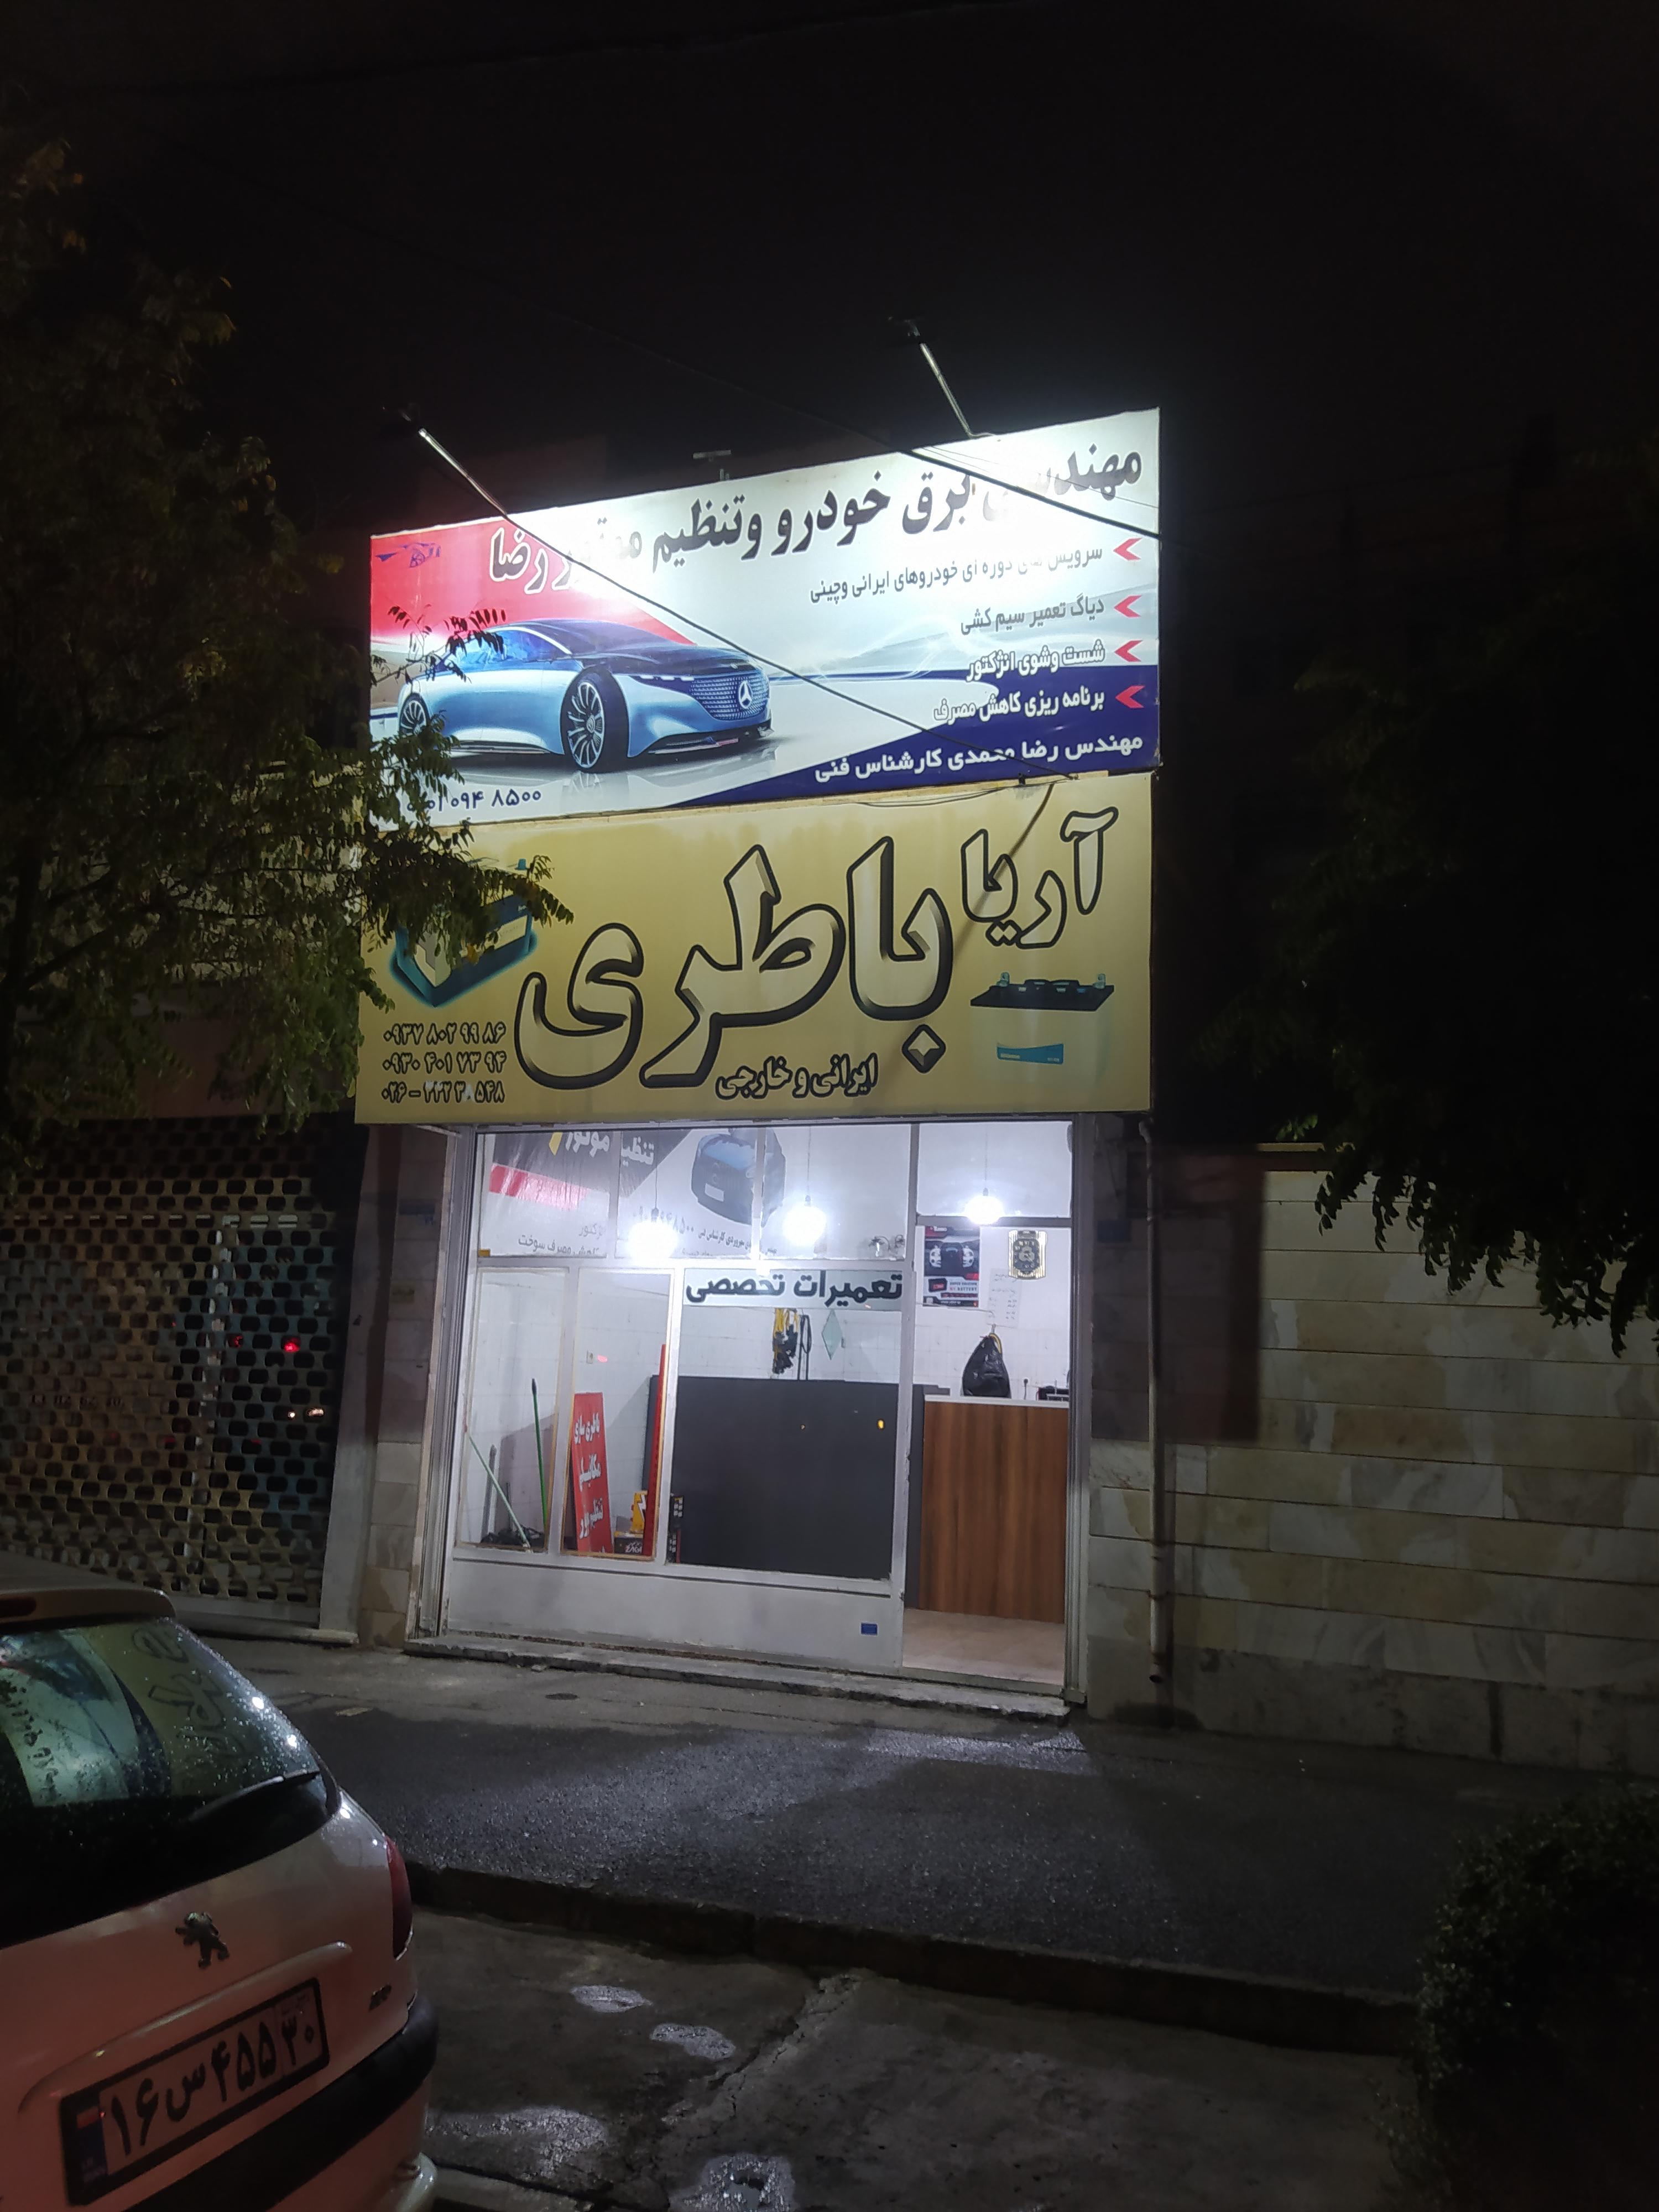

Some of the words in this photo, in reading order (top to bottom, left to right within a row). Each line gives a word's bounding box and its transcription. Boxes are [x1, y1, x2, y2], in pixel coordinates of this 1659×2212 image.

[771, 469, 891, 557] خودرو
[902, 472, 971, 534] برق
[489, 527, 549, 594] رضا
[962, 559, 978, 583] ای
[982, 559, 1013, 580] دوره
[1047, 546, 1103, 571] سرویس
[852, 570, 890, 598] ایرانی
[895, 560, 957, 592] خودروهای
[1029, 602, 1066, 628] تعمیر
[1070, 593, 1105, 620] دیاگ
[961, 607, 992, 635] کشی
[995, 612, 1025, 632] سیم
[966, 649, 1016, 682] انژکتور
[1062, 639, 1105, 665] شست
[933, 698, 977, 726] مصرف
[979, 691, 1022, 722] کاهش
[1024, 689, 1060, 718] ریزی
[1062, 685, 1105, 712] برنامه
[947, 748, 1016, 771] محمدی
[1021, 739, 1059, 762] رضا
[1065, 734, 1144, 761] مهندس
[814, 755, 851, 784] فنی
[854, 747, 943, 779] کارشناس
[451, 790, 484, 810] ۰۹۴
[491, 789, 542, 807] ۸۵۰۰
[961, 806, 1119, 949] آریا
[514, 835, 955, 1091] باطری
[715, 1055, 794, 1100] خارجی
[810, 1052, 879, 1098] ایرانی
[794, 1269, 903, 1308] تعمیرات
[110, 2077, 160, 2156] ۱۶
